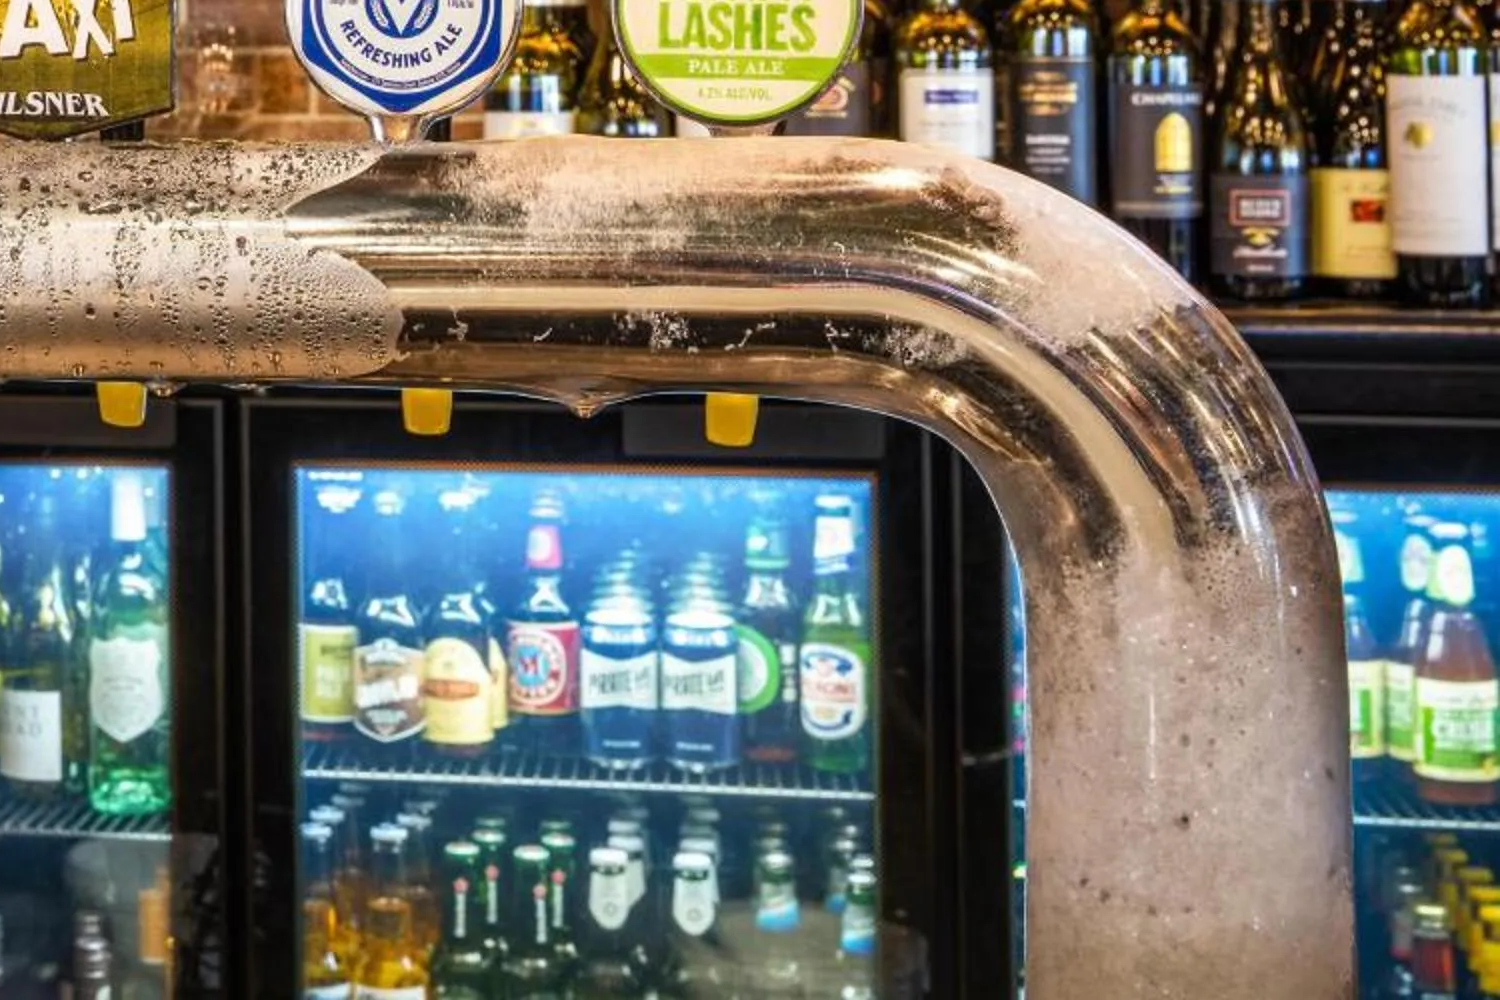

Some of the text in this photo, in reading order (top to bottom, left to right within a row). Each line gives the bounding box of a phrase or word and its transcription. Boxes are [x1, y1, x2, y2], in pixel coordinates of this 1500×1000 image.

[340, 19, 463, 69] REFRESHING ALE
[658, 2, 817, 51] LASHES
[687, 58, 785, 75] PALE ALE
